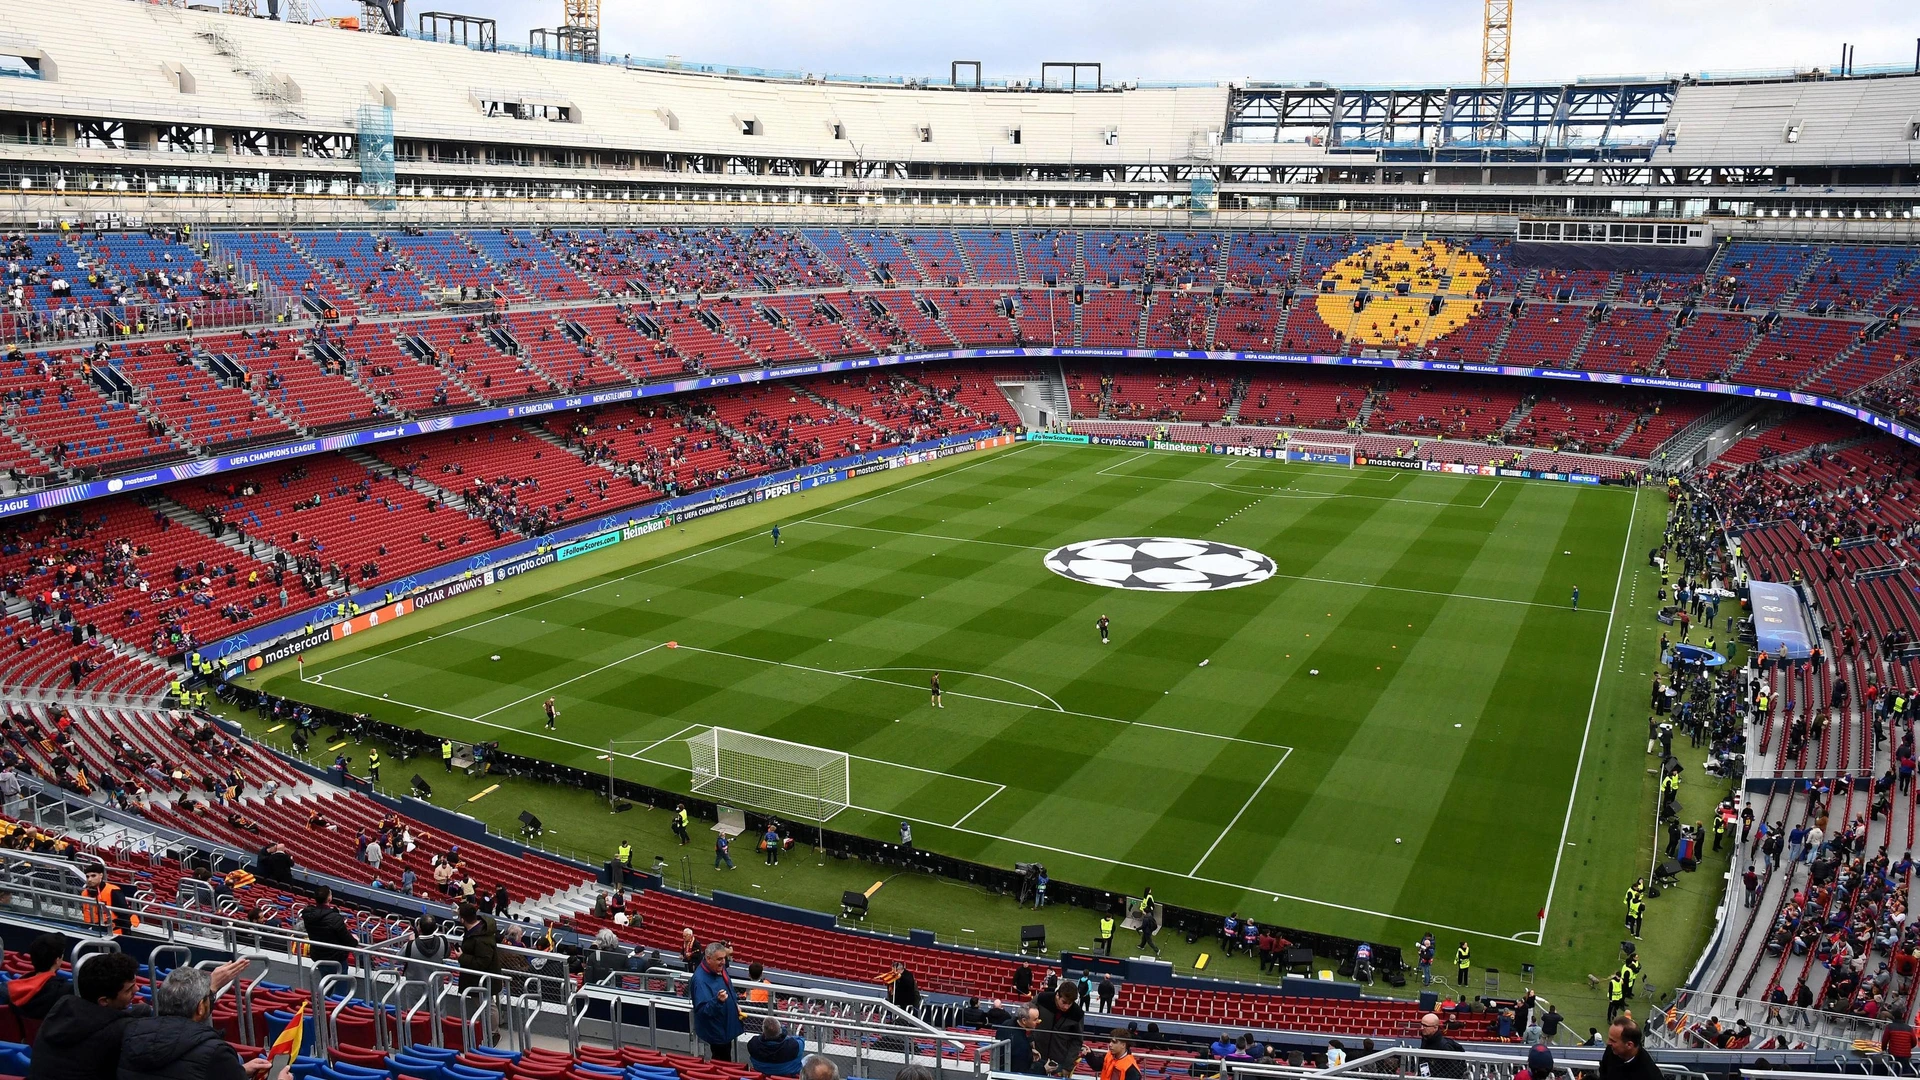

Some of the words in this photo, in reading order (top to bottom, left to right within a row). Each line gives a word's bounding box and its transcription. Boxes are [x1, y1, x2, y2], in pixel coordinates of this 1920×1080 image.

[1478, 365, 1498, 373] LEAGUE
[1646, 379, 1679, 387] CHAMPIONS
[1679, 381, 1702, 389] LEAGUE
[519, 407, 525, 415] FC
[525, 403, 554, 414] BARCELONA
[566, 398, 582, 407] 52:40
[593, 392, 617, 403] NEWCASTLE
[617, 391, 632, 400] UNITED
[1100, 437, 1145, 448] crypto.com
[1153, 441, 1198, 453] Heineken
[230, 456, 248, 466] UEFA
[249, 447, 290, 462] CHAMPIONS
[290, 443, 316, 454] LEAGUE
[937, 447, 953, 458] QATAR
[1226, 447, 1261, 458] PEPSI
[1313, 454, 1337, 462] PS5
[856, 461, 889, 476] mastercard
[1368, 458, 1420, 469] mastercard
[1426, 460, 1453, 473] FedEx
[1464, 464, 1491, 477] FedEx
[124, 473, 157, 486] mastercard
[819, 475, 837, 484] PS5
[765, 485, 791, 500] PEPSI
[684, 510, 698, 520] UEFA
[698, 502, 727, 516] CHAMPIONS
[728, 497, 746, 508] LEAGUE
[622, 519, 664, 541] Heineken
[507, 553, 554, 576] crypto.com
[415, 588, 445, 609] QATAR
[447, 576, 483, 597] AIRWAYS
[265, 629, 331, 664] mastercard
